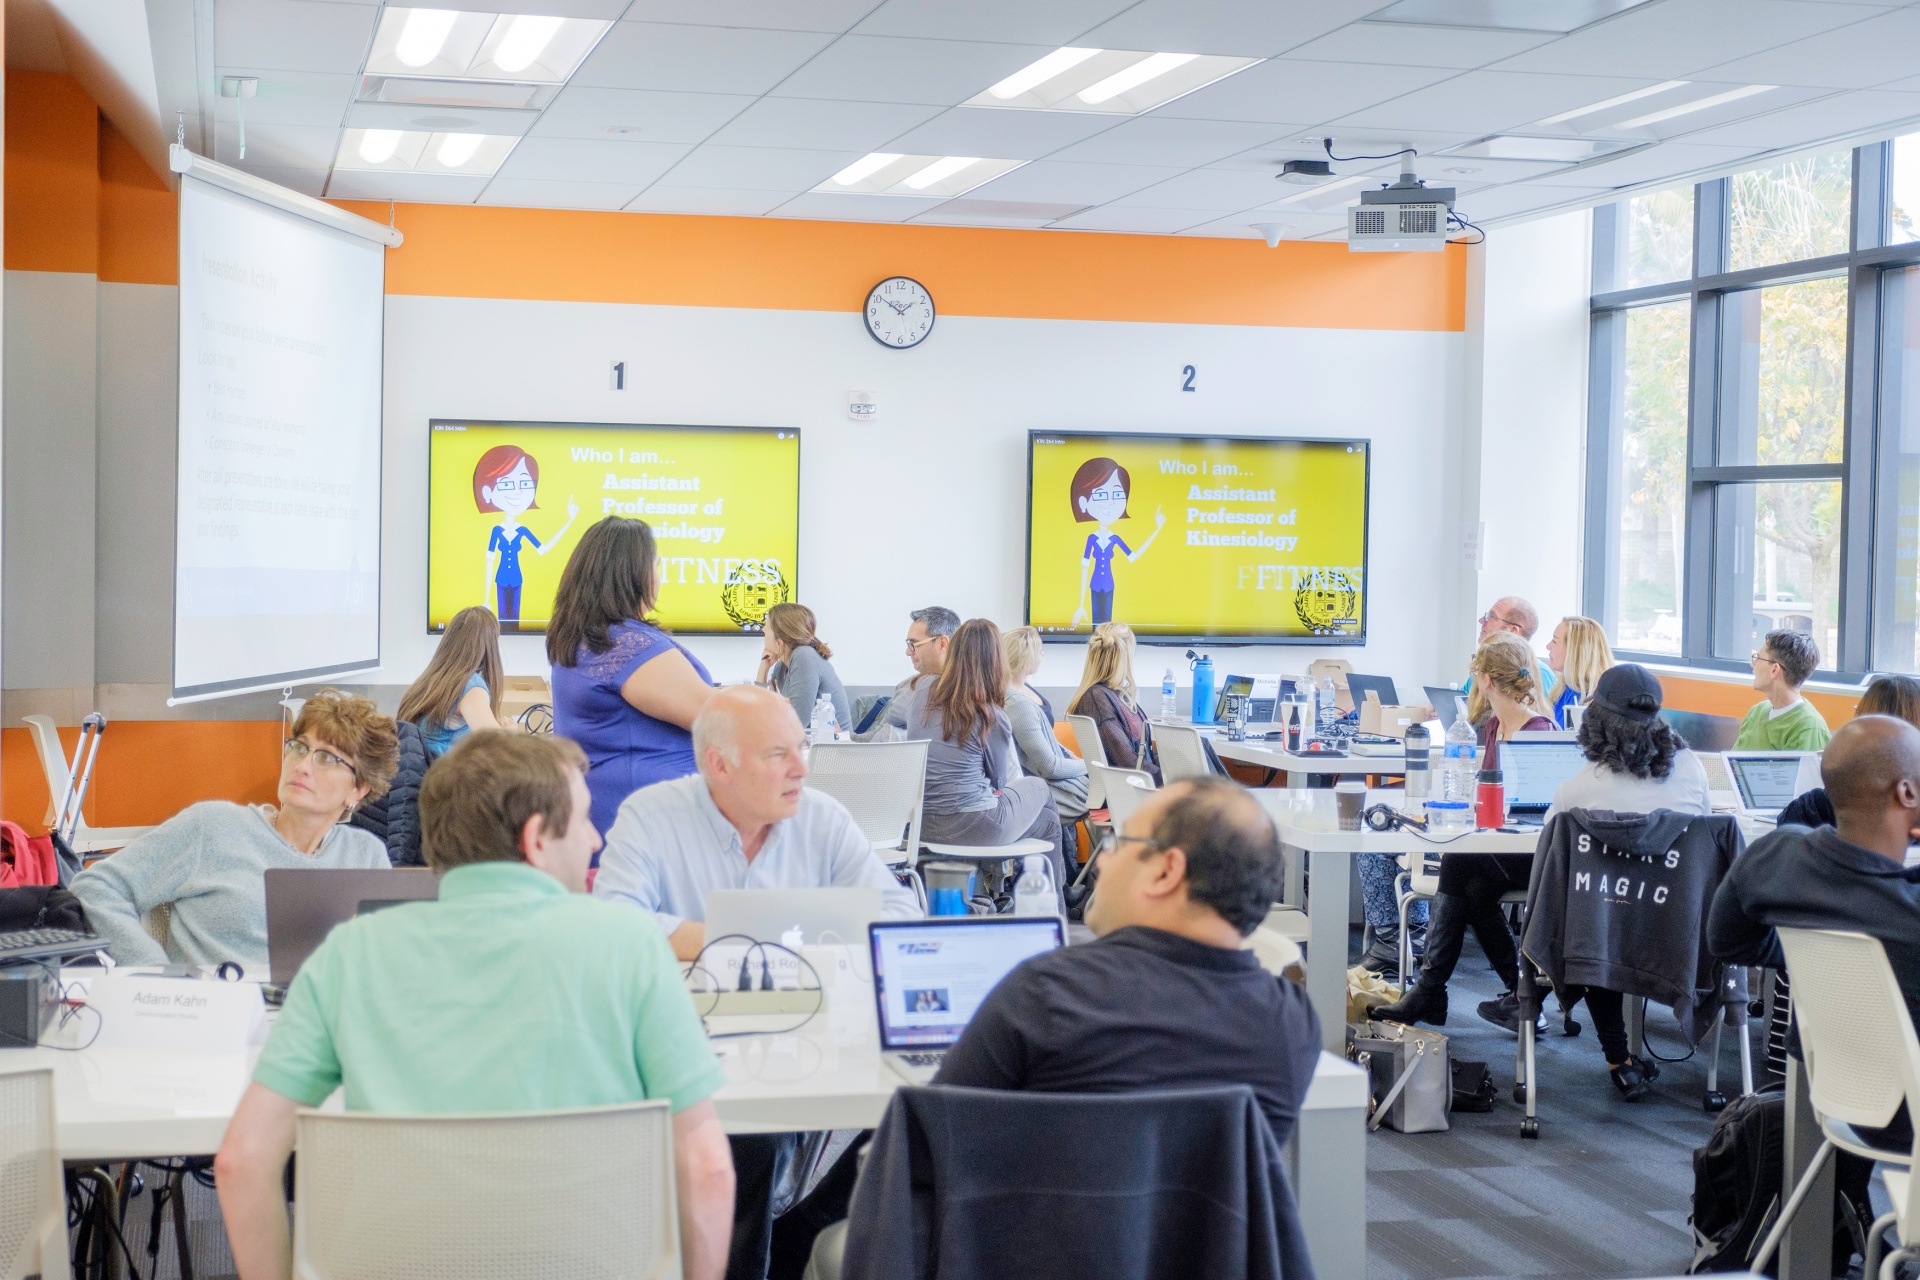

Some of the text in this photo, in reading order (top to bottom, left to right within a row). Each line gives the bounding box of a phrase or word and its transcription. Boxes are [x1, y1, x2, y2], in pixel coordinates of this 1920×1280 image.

[885, 285, 891, 294] 11
[896, 281, 906, 290] 12
[911, 286, 915, 294] 1
[920, 296, 926, 304] 2
[871, 308, 876, 317] 9
[924, 309, 930, 318] 3
[874, 321, 880, 329] 8
[920, 322, 926, 330] 4
[885, 332, 890, 340] 7
[898, 335, 903, 344] 6
[910, 332, 916, 341] 5
[614, 362, 624, 390] 1
[1183, 365, 1195, 392] 2
[571, 447, 676, 464] Who I am...
[1159, 459, 1254, 476] Who I am...
[602, 473, 700, 491] Assistant
[1187, 484, 1276, 502] Assistant
[602, 497, 724, 515] Professor of
[1186, 507, 1297, 525] Professor of
[652, 521, 726, 543] siology
[1186, 530, 1298, 552] Kinesiology
[660, 558, 781, 585] ITNESS
[1575, 872, 1669, 904] MAGIC
[728, 959, 774, 970] Rihad
[132, 992, 207, 1007] Adam Kahn
